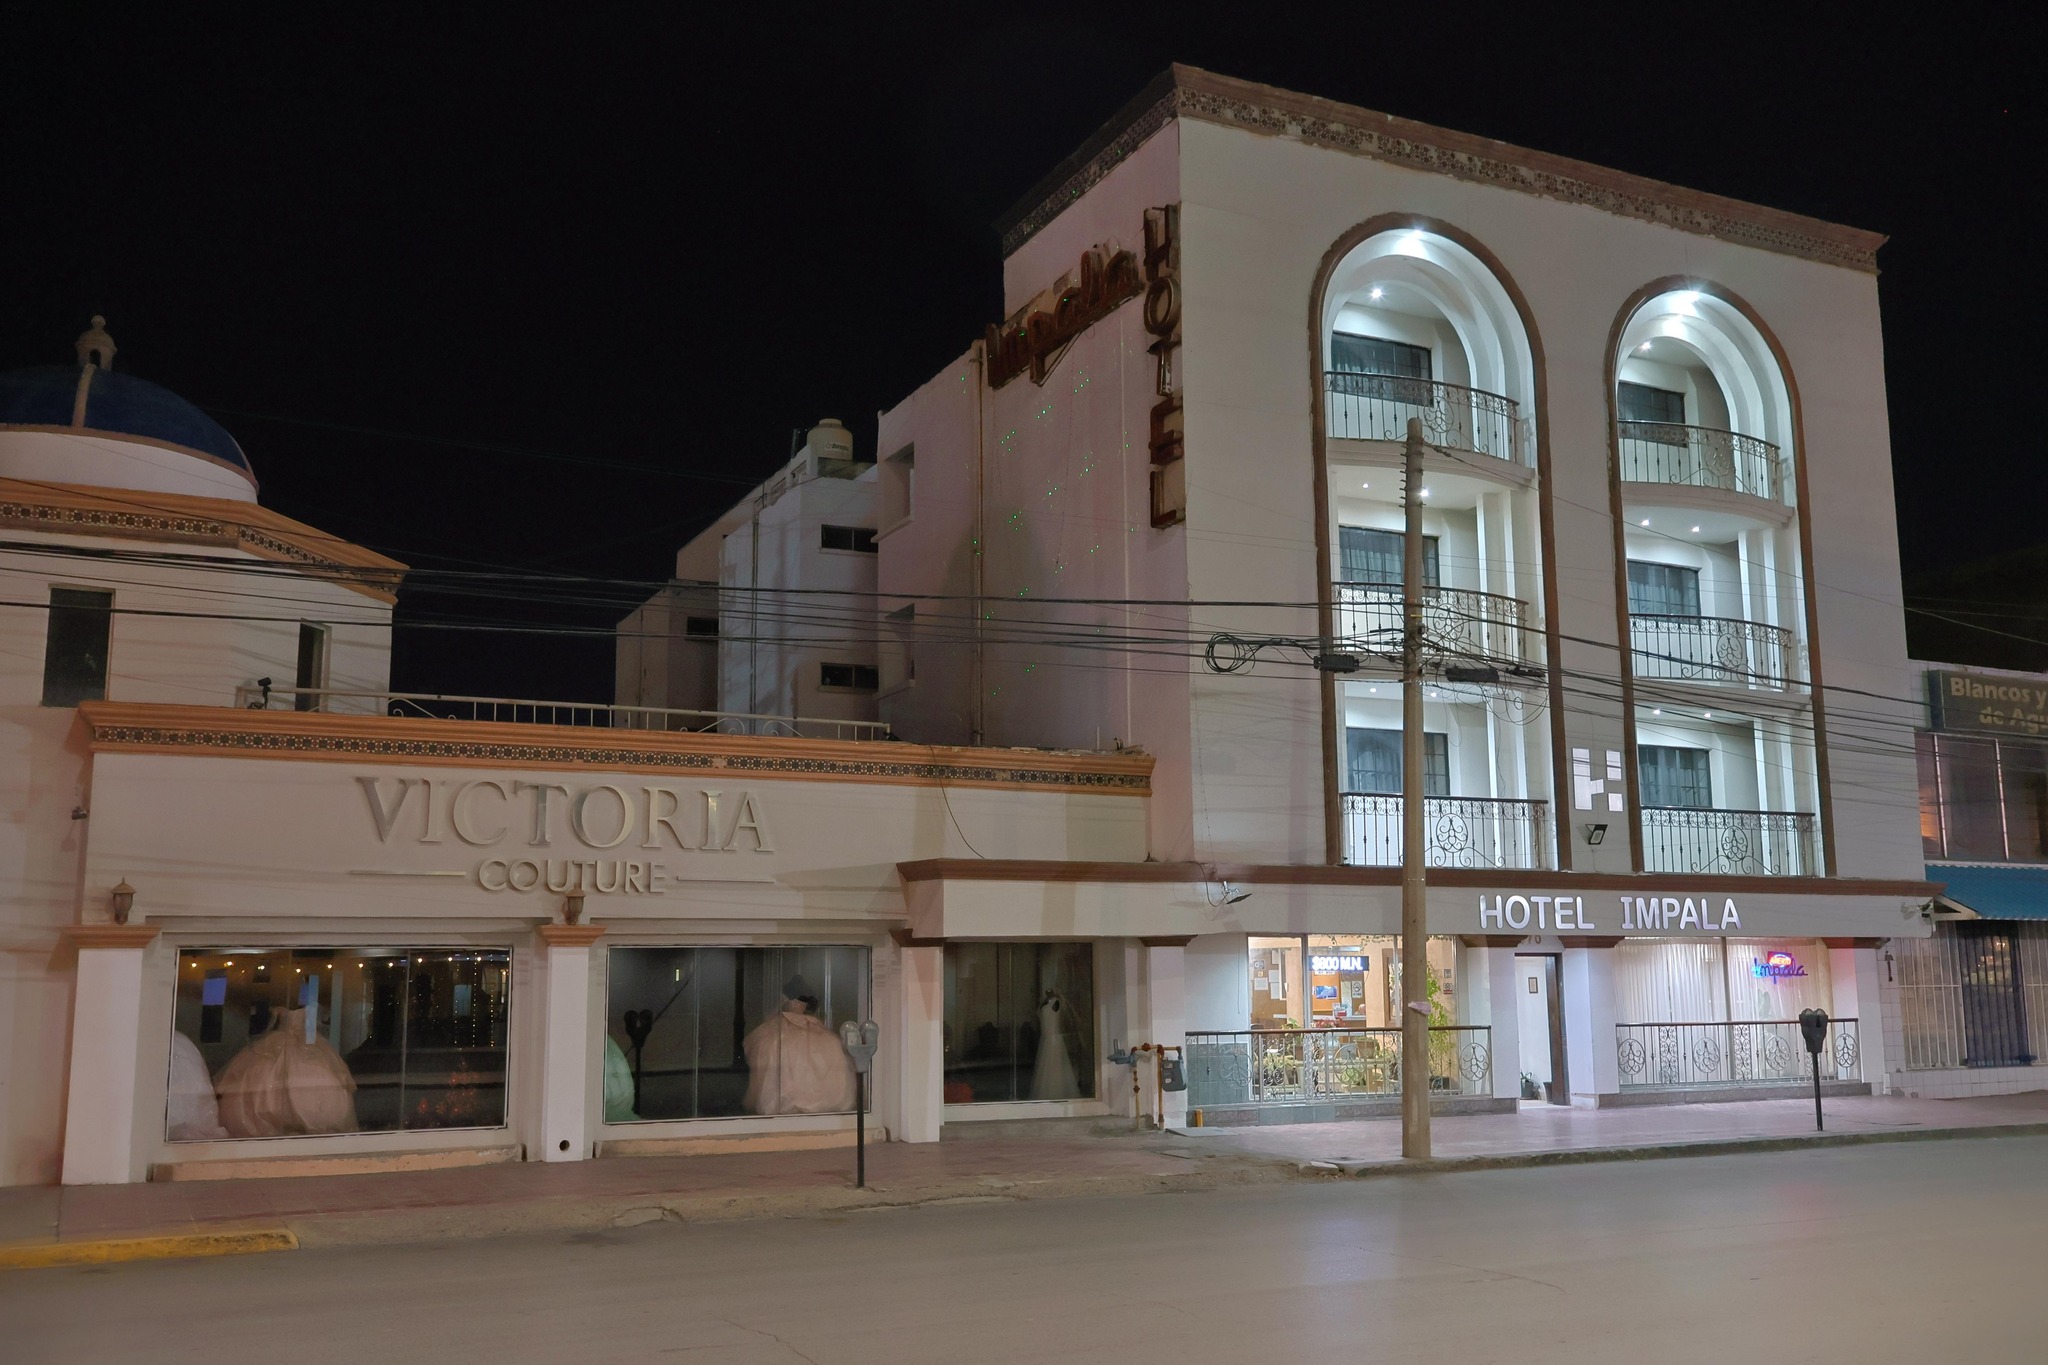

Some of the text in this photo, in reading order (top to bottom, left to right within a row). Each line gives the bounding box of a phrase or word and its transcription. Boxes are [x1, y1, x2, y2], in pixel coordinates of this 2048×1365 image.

[1143, 204, 1186, 529] HOTEL
[1950, 677, 2047, 710] Blancos y
[1979, 706, 2005, 725] de
[355, 776, 775, 853] VICTORIA
[478, 858, 667, 894] COUTURE
[1479, 894, 1742, 931] HOTEL IMPALA
[1752, 957, 1809, 985] Impala
